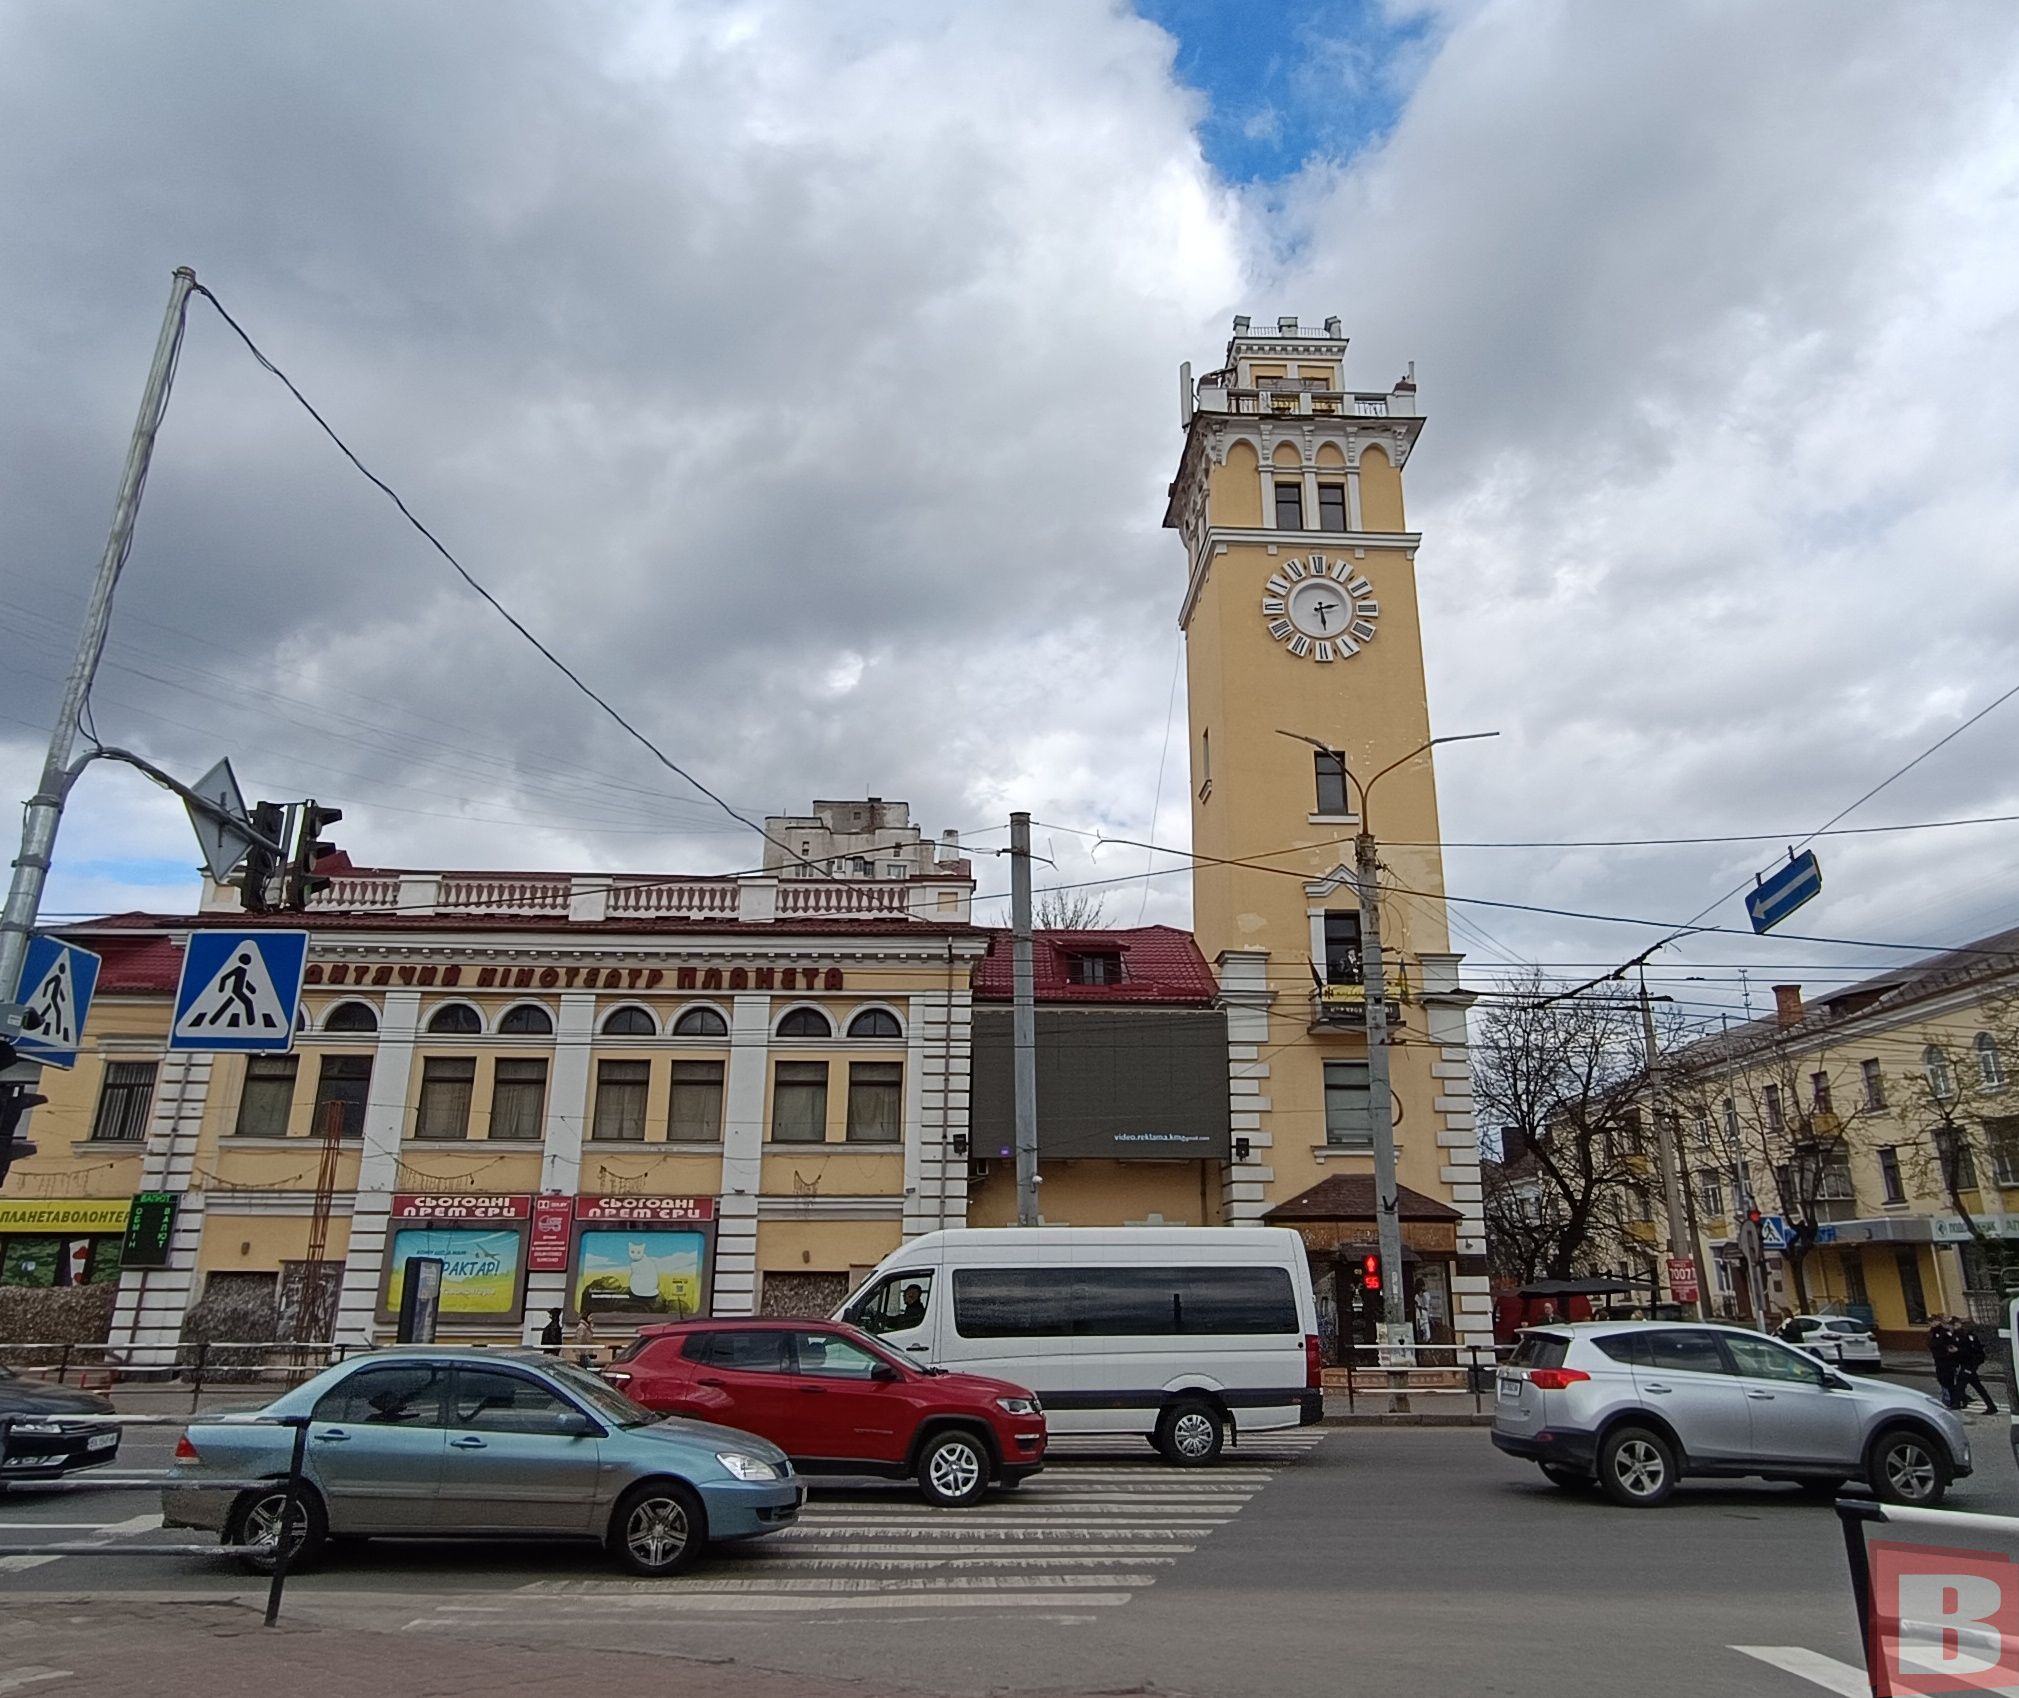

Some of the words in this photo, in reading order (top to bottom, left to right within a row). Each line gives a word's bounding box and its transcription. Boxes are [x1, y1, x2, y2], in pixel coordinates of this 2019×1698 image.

[677, 967, 844, 990] ПЛАНЕТА
[414, 1197, 510, 1207] СЬОГОДНІ
[599, 1199, 694, 1208] СЬОГОДНІ
[157, 1207, 171, 1248] ВАЛЮТ
[443, 1260, 500, 1276] РАКТАР!
